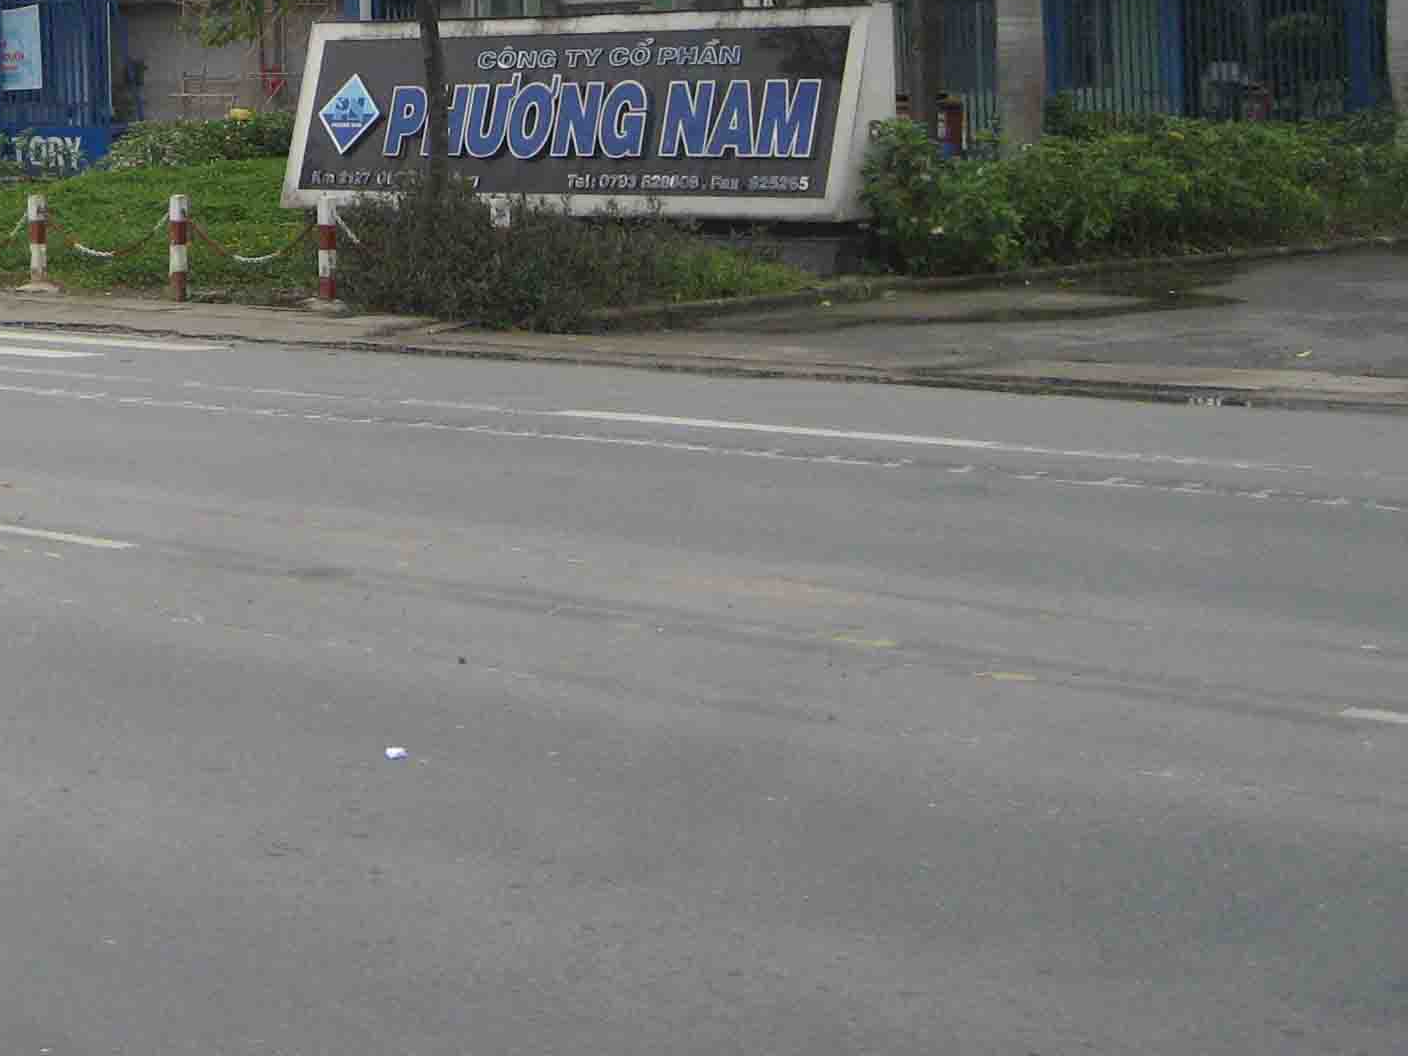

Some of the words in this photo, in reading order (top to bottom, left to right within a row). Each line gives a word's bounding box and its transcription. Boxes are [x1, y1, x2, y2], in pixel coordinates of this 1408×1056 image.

[477, 46, 558, 69] CÔNG
[565, 48, 603, 68] TY
[608, 37, 655, 66] CỔ
[658, 79, 822, 158] NAM
